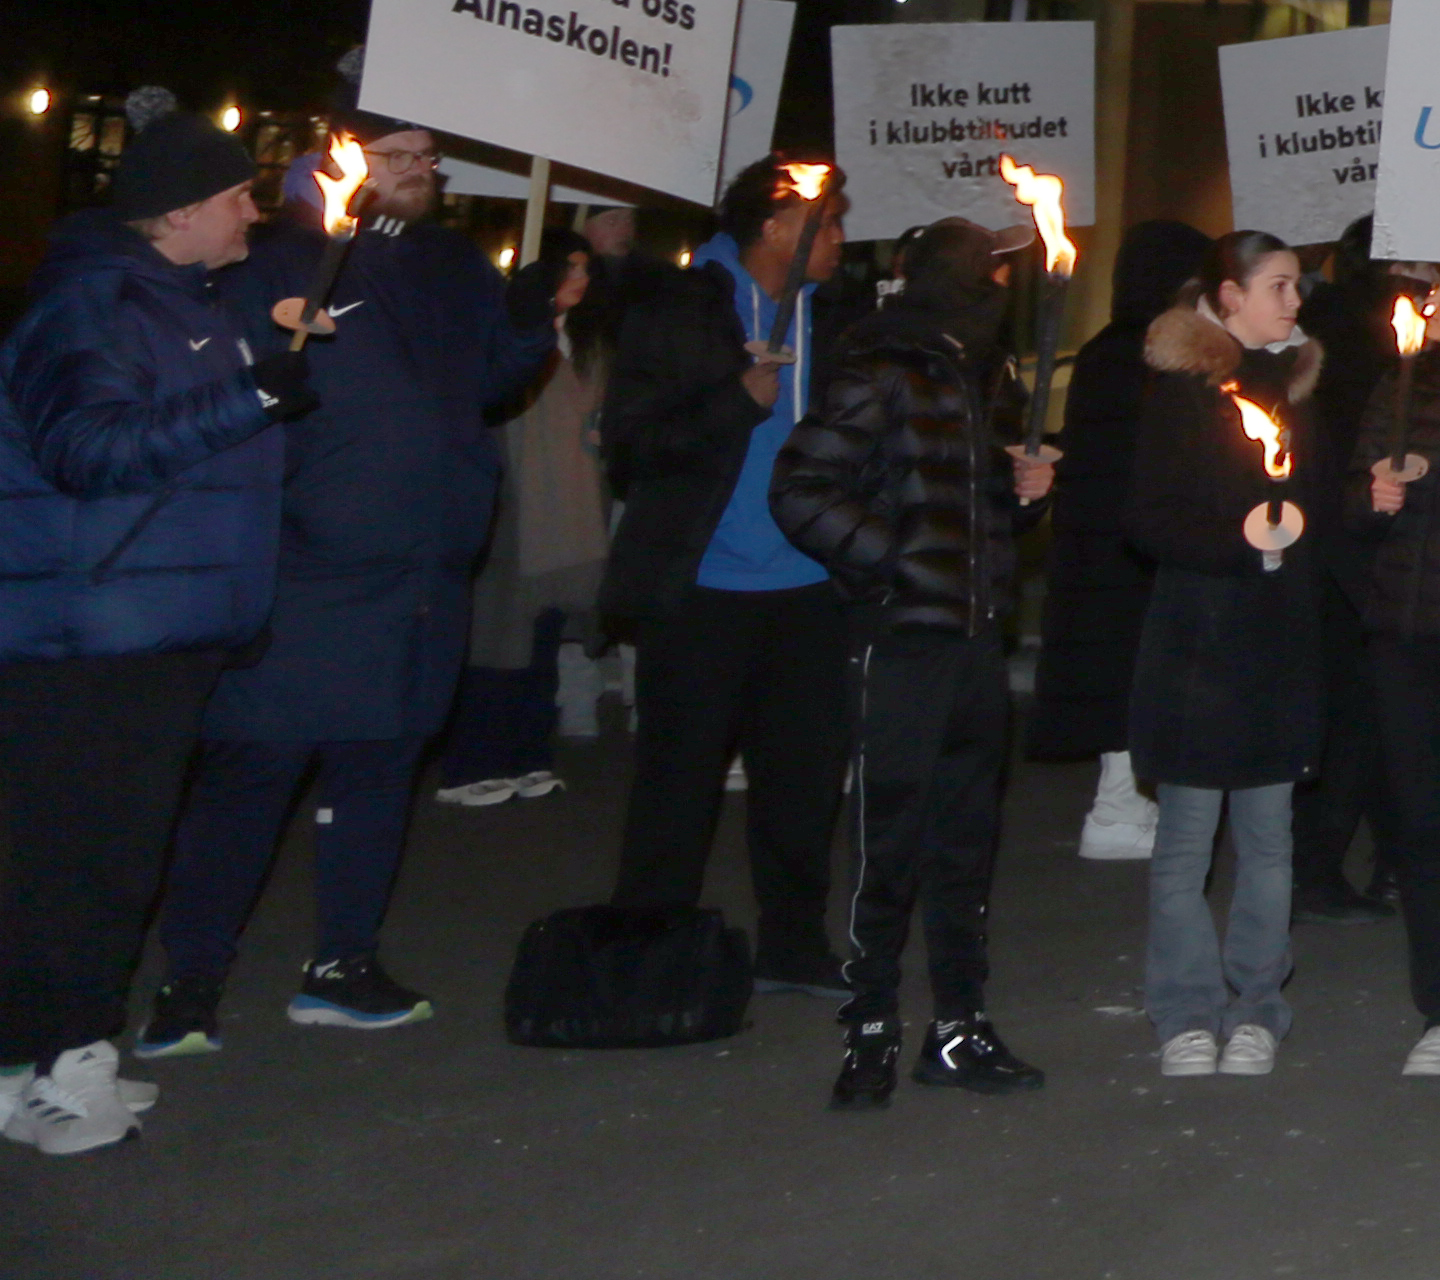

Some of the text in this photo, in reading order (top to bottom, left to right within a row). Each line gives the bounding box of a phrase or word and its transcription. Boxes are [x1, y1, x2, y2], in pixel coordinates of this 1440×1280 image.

[911, 82, 1031, 107] Ikke kutt
[1296, 91, 1356, 118] Ikke
[869, 115, 1068, 145] i klubbtilbudet
[1259, 134, 1267, 158] i
[942, 152, 1001, 179] vårt
